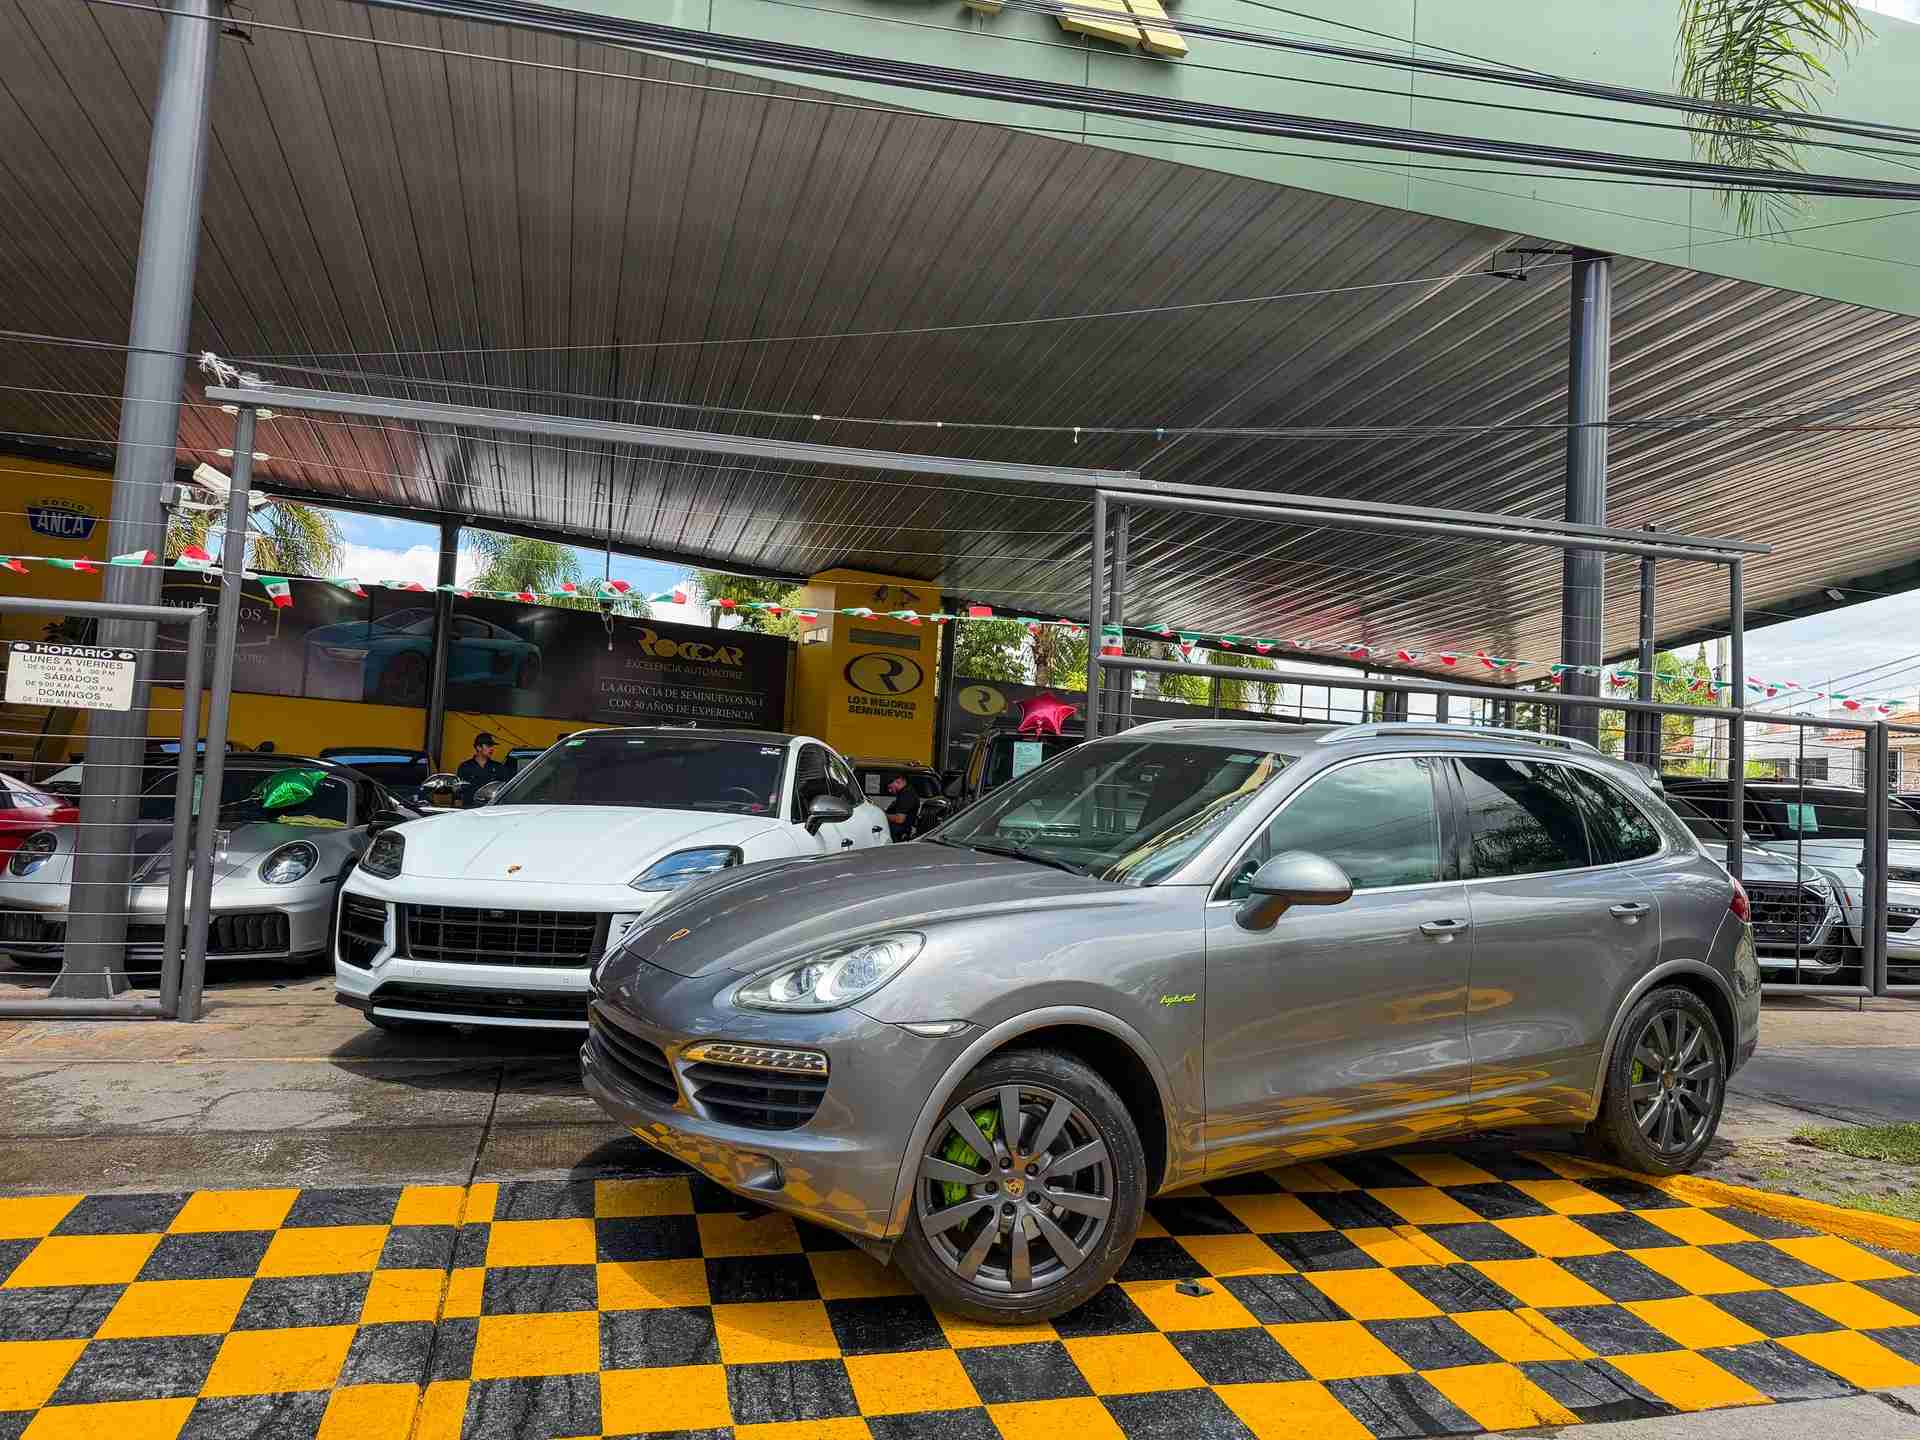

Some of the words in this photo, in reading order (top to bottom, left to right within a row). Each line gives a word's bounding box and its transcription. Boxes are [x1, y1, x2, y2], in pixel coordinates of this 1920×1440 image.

[36, 510, 84, 534] ANCA
[36, 644, 113, 659] HORARIO
[627, 625, 744, 666] ROCCAR
[23, 655, 60, 665] LUNES
[76, 659, 124, 670] VIERNES
[44, 672, 99, 684] SÁBADOS
[38, 688, 101, 700] DOMINGOS
[601, 680, 616, 692] LA
[615, 682, 664, 698] AGENCIA
[665, 687, 678, 698] DE
[680, 688, 744, 705] SEMINUEVOS
[847, 695, 867, 705] LOS
[608, 698, 631, 709] CON
[646, 699, 674, 713] AÑOS
[675, 703, 689, 714] DE
[691, 705, 756, 721] EXPERIENCIA
[847, 704, 914, 720] SEMINUEVOS
